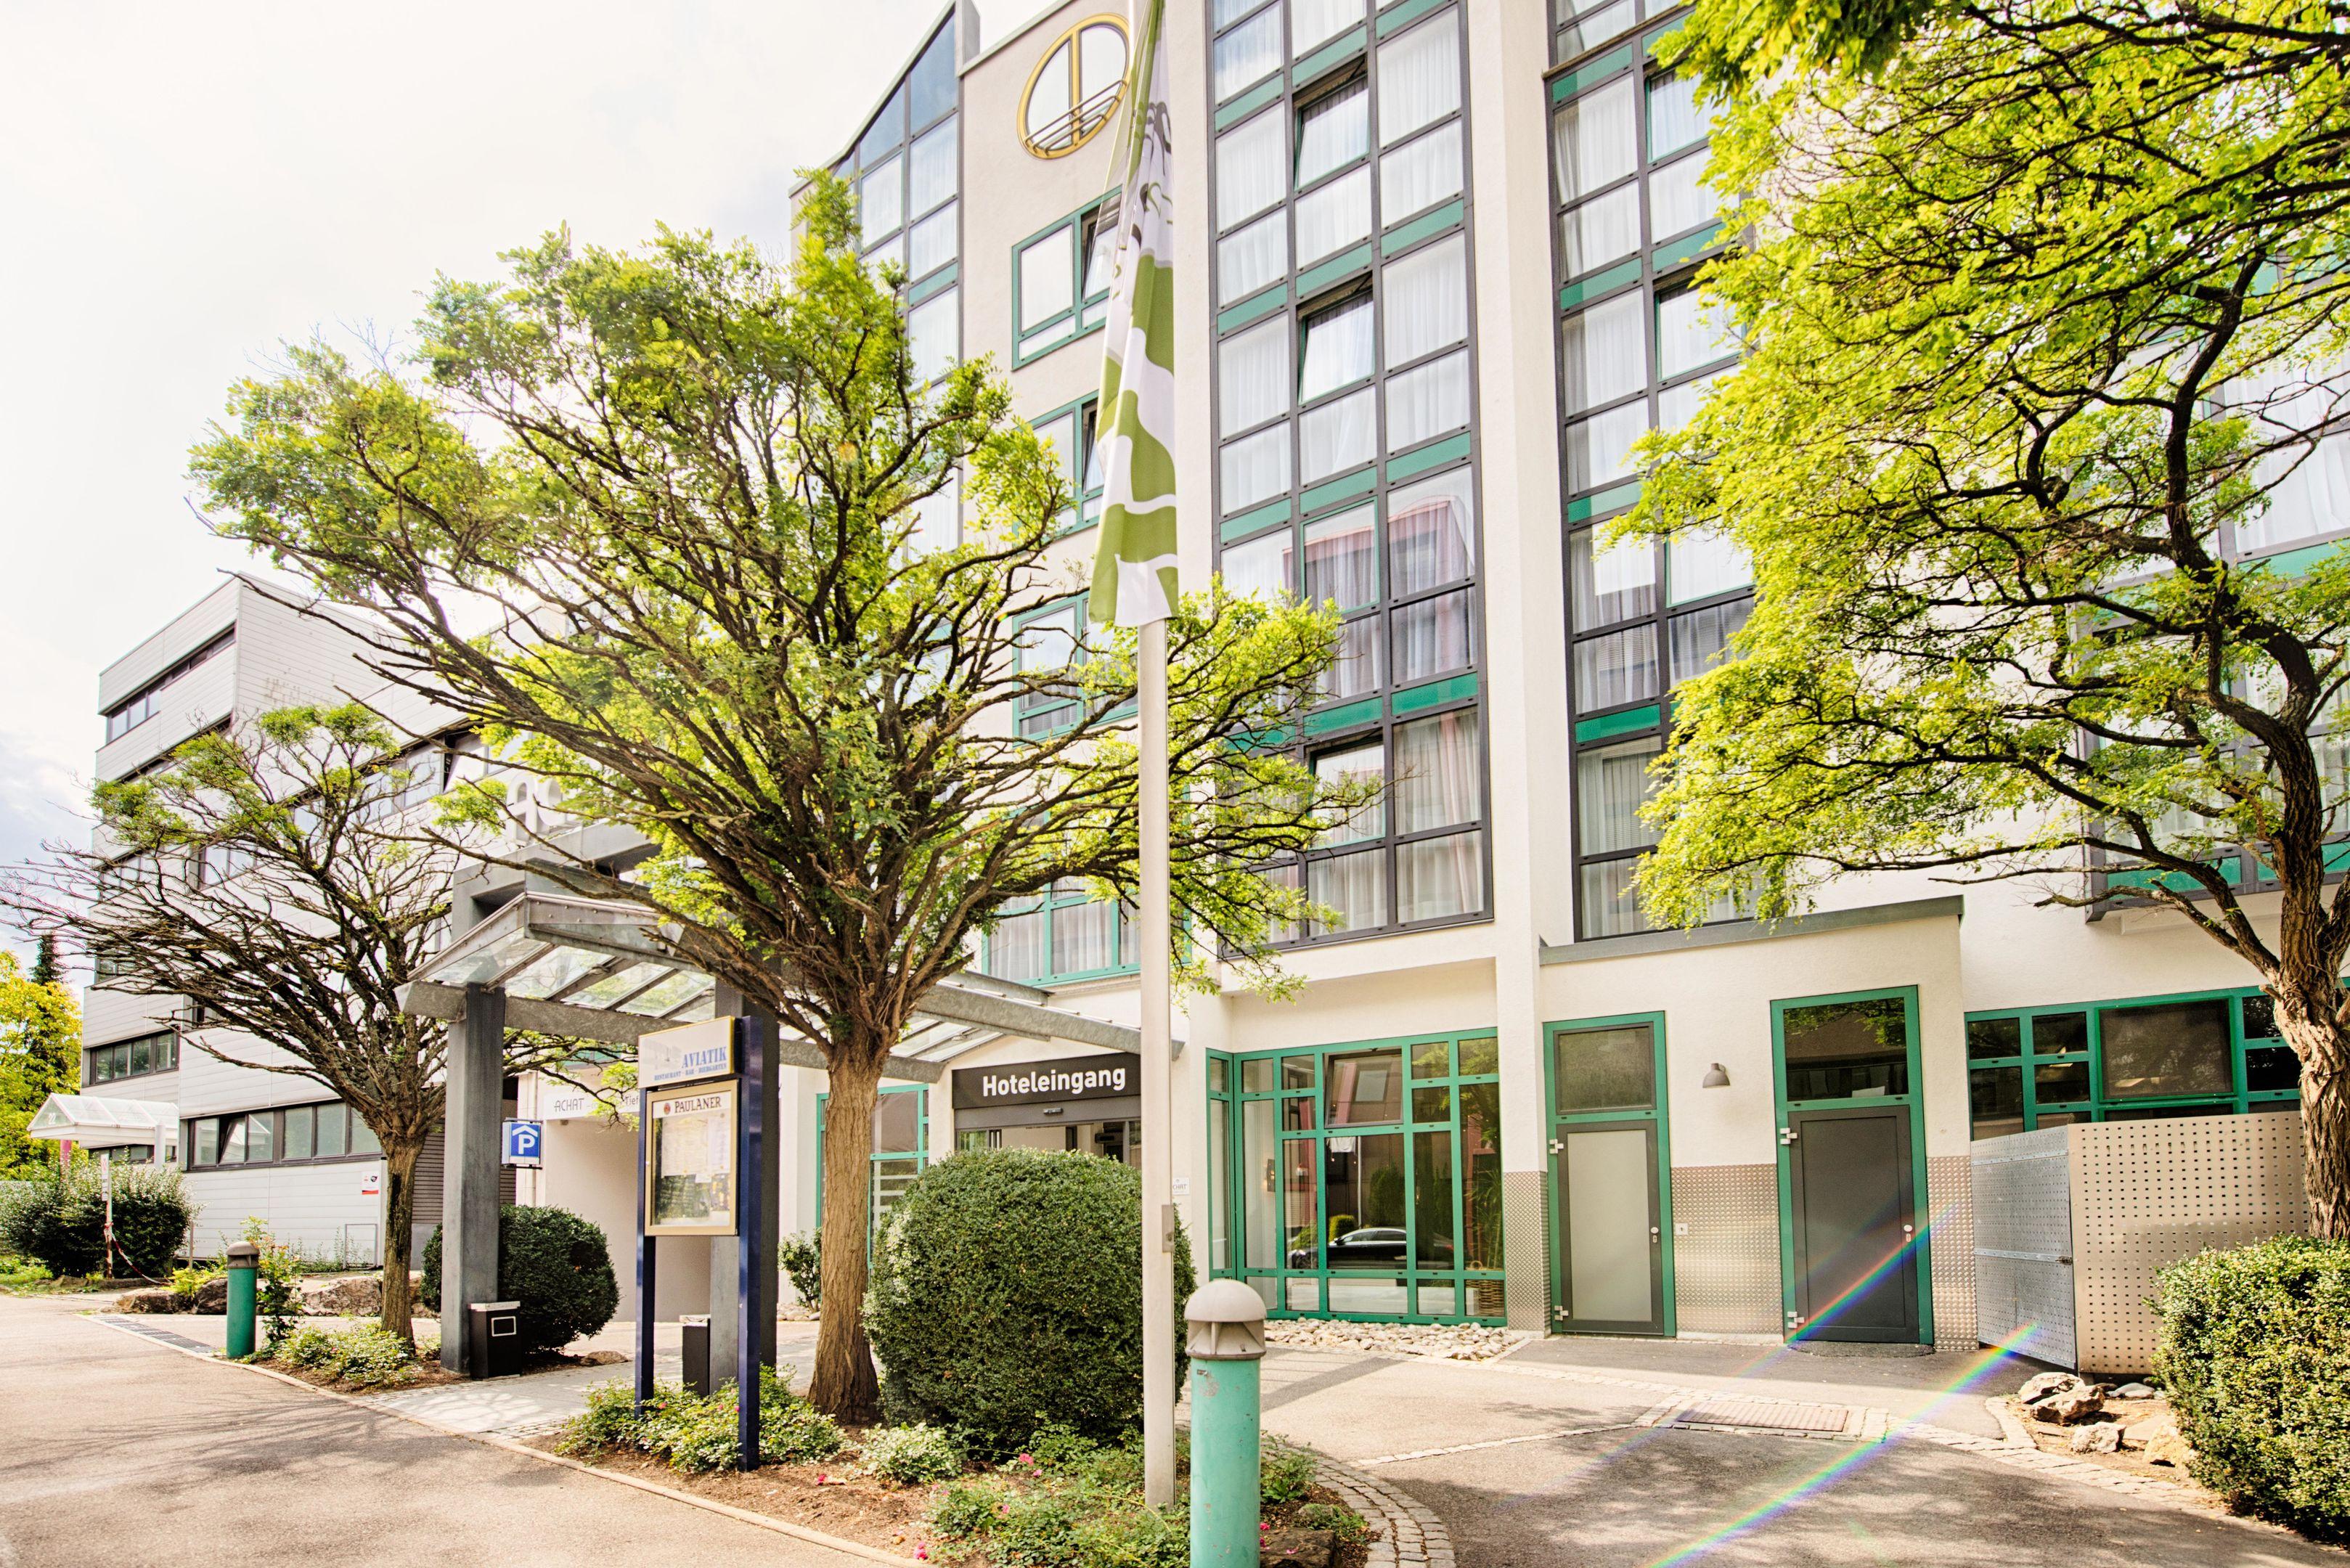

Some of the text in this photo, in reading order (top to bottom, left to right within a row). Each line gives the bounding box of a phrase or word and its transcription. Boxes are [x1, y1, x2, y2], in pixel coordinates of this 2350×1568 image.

[682, 1047, 727, 1069] AVIATIK
[654, 1071, 681, 1081] RESTAURANT
[982, 1068, 1126, 1097] Hoteleingang
[554, 1097, 585, 1113] ACHAT
[674, 1096, 722, 1114] PAULANER
[518, 1134, 536, 1155] P
